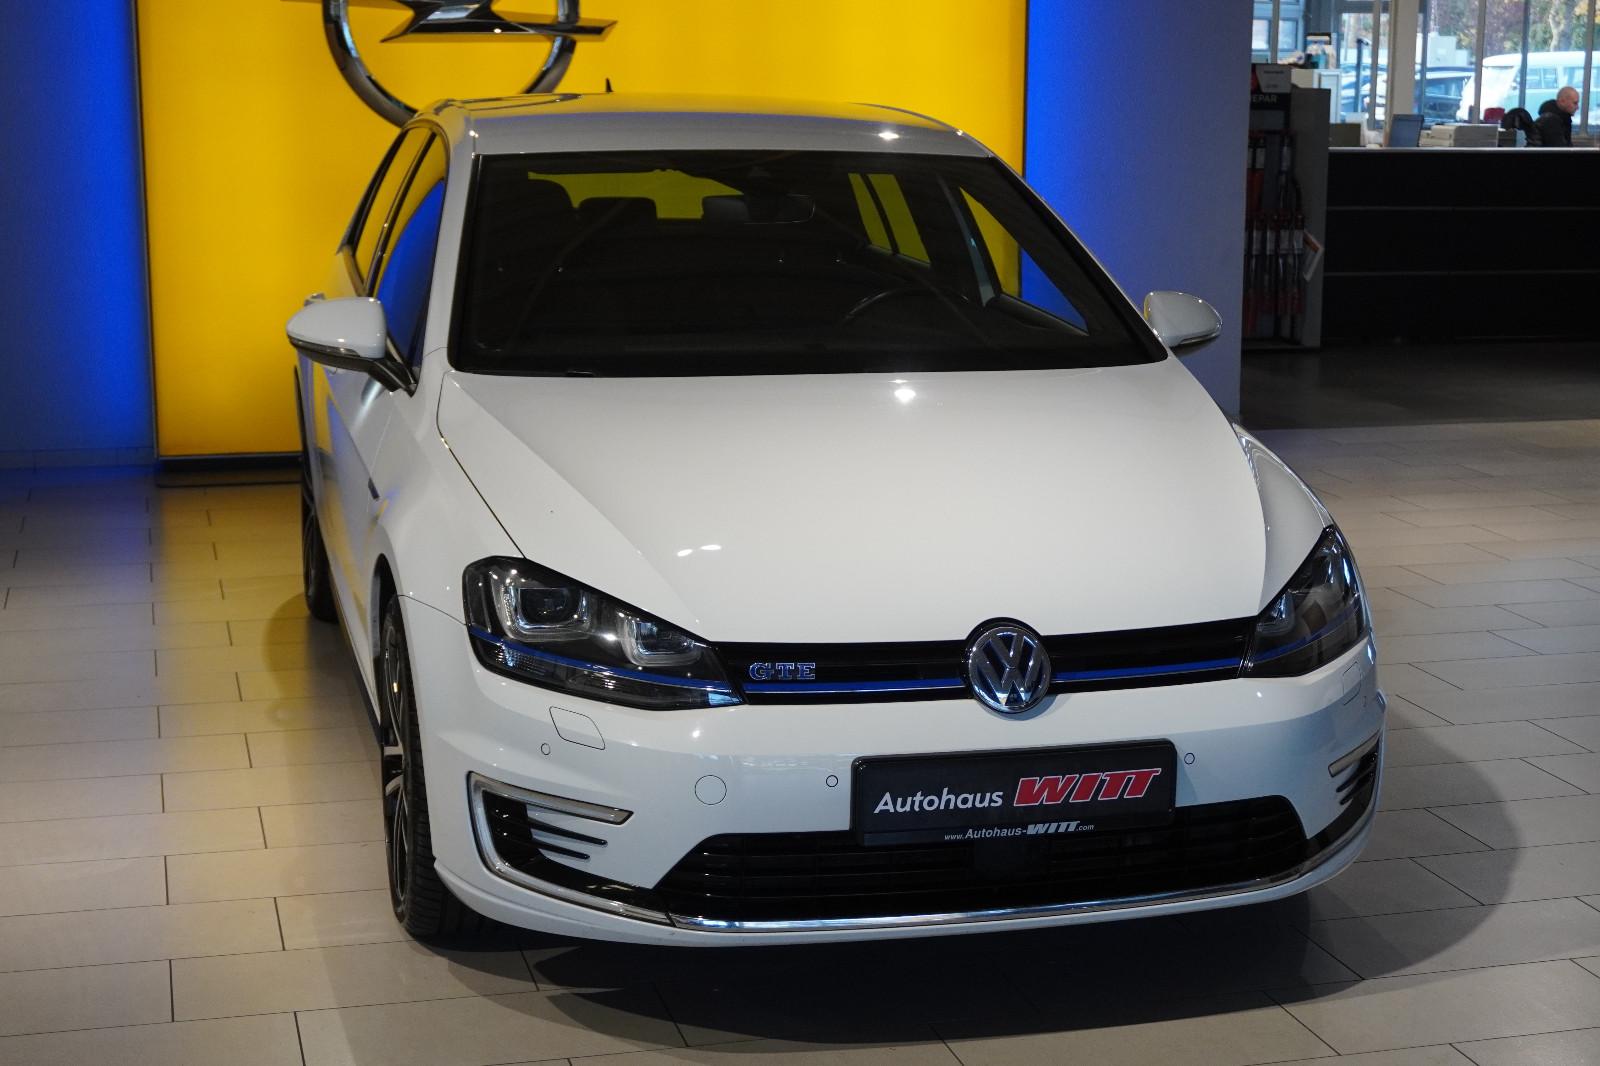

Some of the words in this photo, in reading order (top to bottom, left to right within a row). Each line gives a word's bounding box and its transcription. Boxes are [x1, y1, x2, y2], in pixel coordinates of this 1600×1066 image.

[749, 662, 816, 680] GTE
[873, 787, 1004, 814] Autohaus
[1013, 767, 1162, 808] WITT
[944, 820, 1095, 841] www.Autohaus-WITT.com
